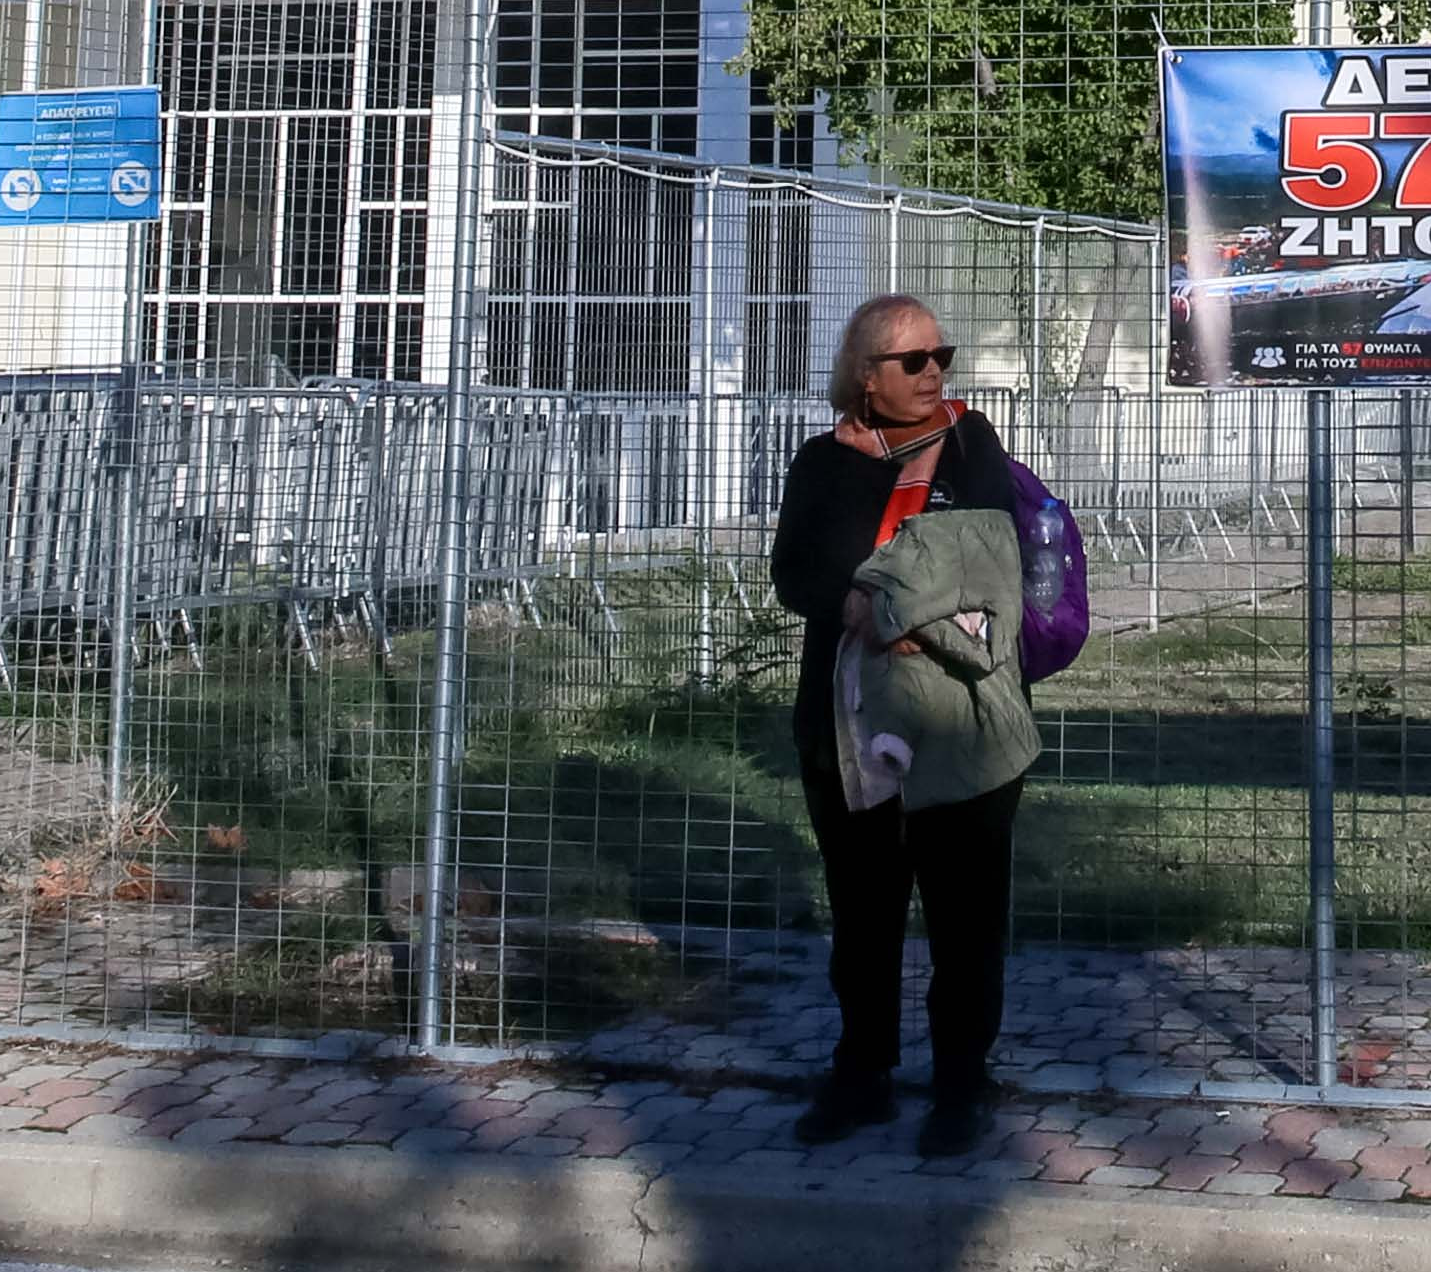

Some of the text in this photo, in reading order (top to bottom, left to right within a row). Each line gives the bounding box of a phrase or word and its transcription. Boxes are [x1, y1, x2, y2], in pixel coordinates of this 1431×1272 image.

[41, 106, 117, 119] ΑΠΑΓΟΡΕΥΕΤΑ
[1295, 342, 1422, 355] ΓΙΑ ΤΑ 57 ΘΥΜΑΤΑ
[1295, 358, 1318, 368] ΓΙΑ
[1321, 358, 1358, 368] ΤΟΥΣ
